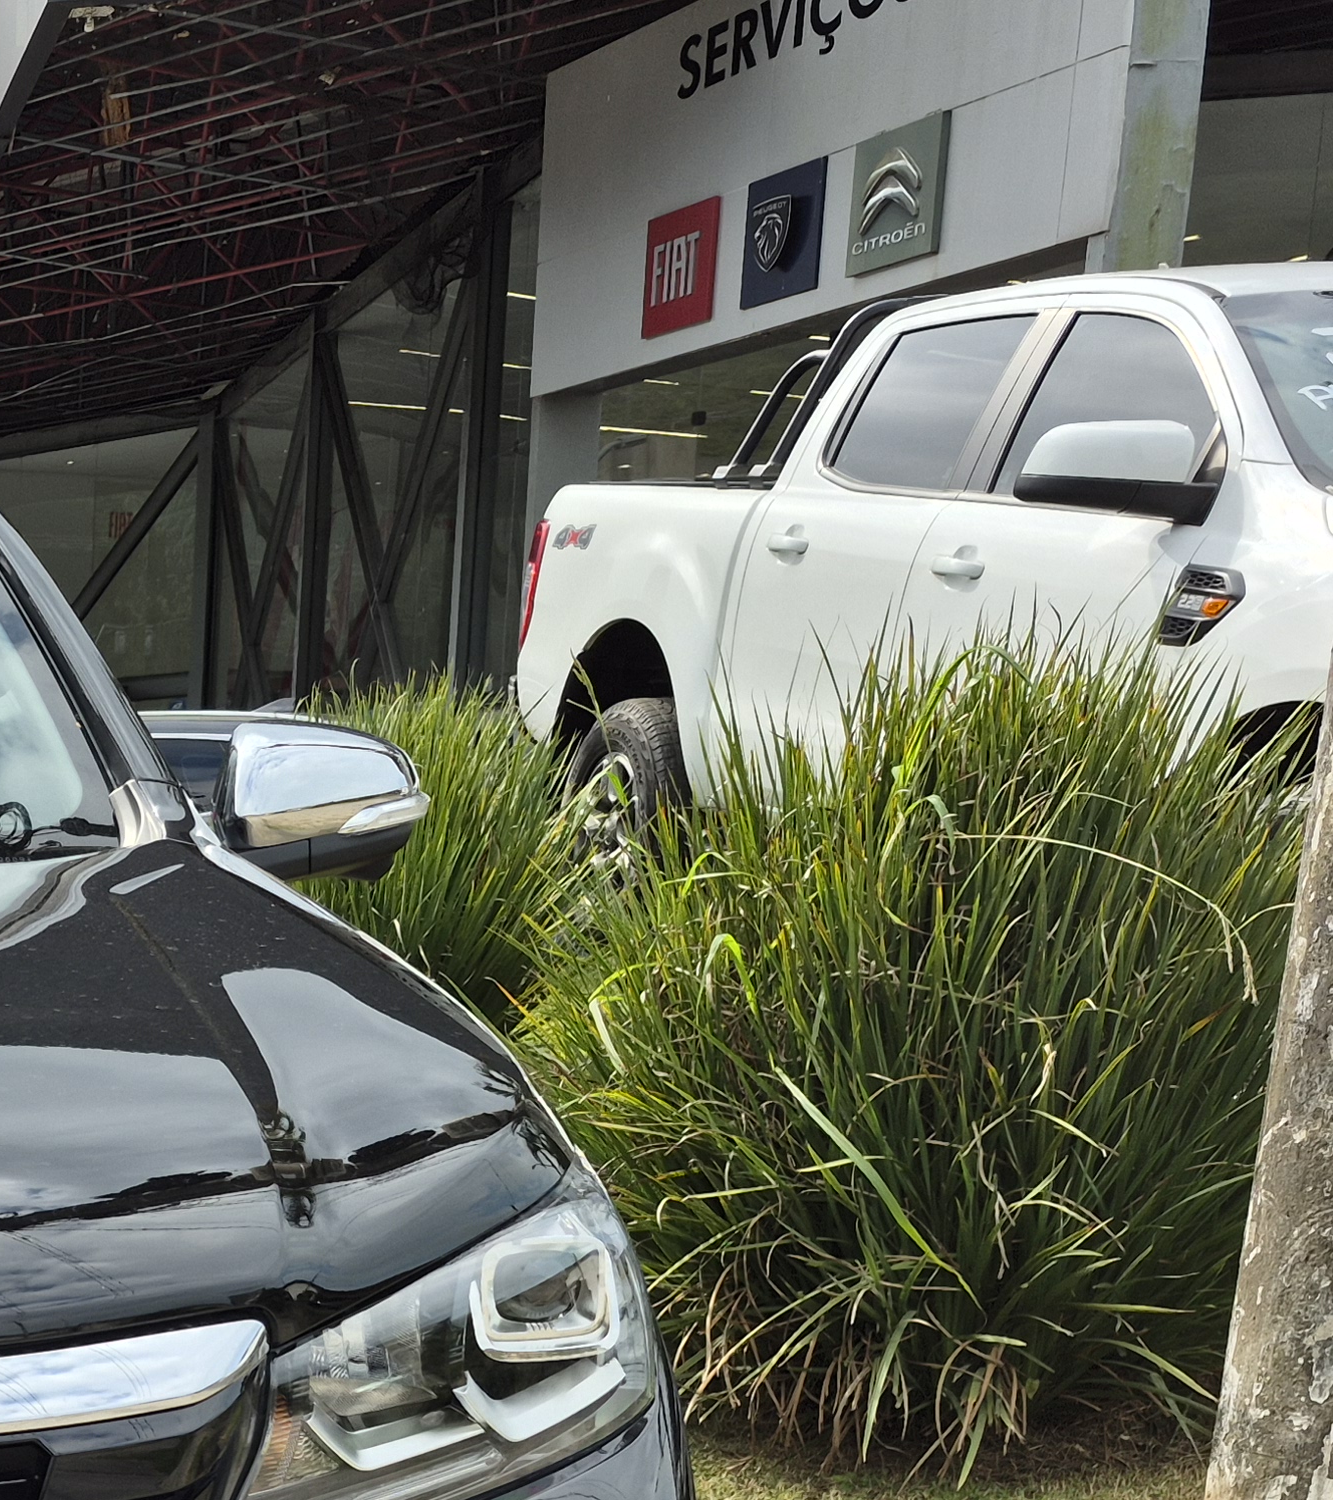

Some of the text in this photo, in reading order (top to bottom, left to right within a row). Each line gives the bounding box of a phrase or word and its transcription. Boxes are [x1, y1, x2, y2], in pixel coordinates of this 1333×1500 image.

[677, 0, 909, 100] SERVIÇ
[752, 200, 788, 218] PEUGEOT
[650, 230, 702, 308] FIAT
